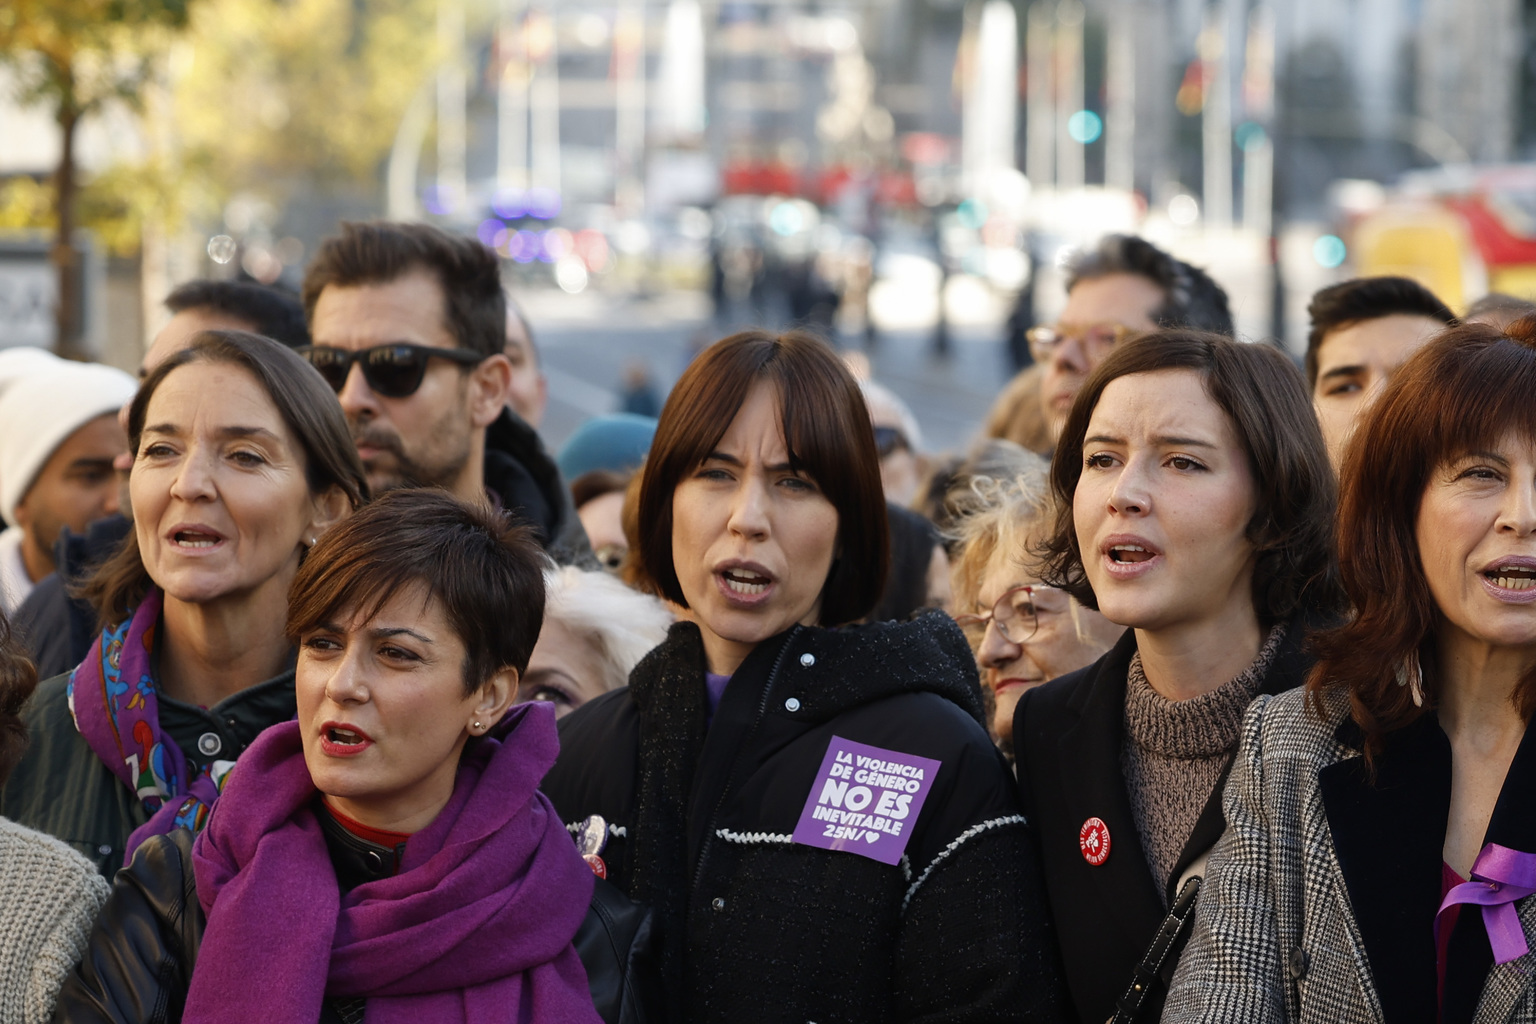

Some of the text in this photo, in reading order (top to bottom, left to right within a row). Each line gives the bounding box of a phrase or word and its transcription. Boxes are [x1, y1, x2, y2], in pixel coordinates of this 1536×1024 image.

[829, 763, 921, 794] DE GÉNERO
[835, 750, 924, 780] LA VIOLENCIA
[818, 778, 914, 820] NO ES
[812, 805, 904, 836] INEVITABLE
[1085, 828, 1099, 848] PSOE
